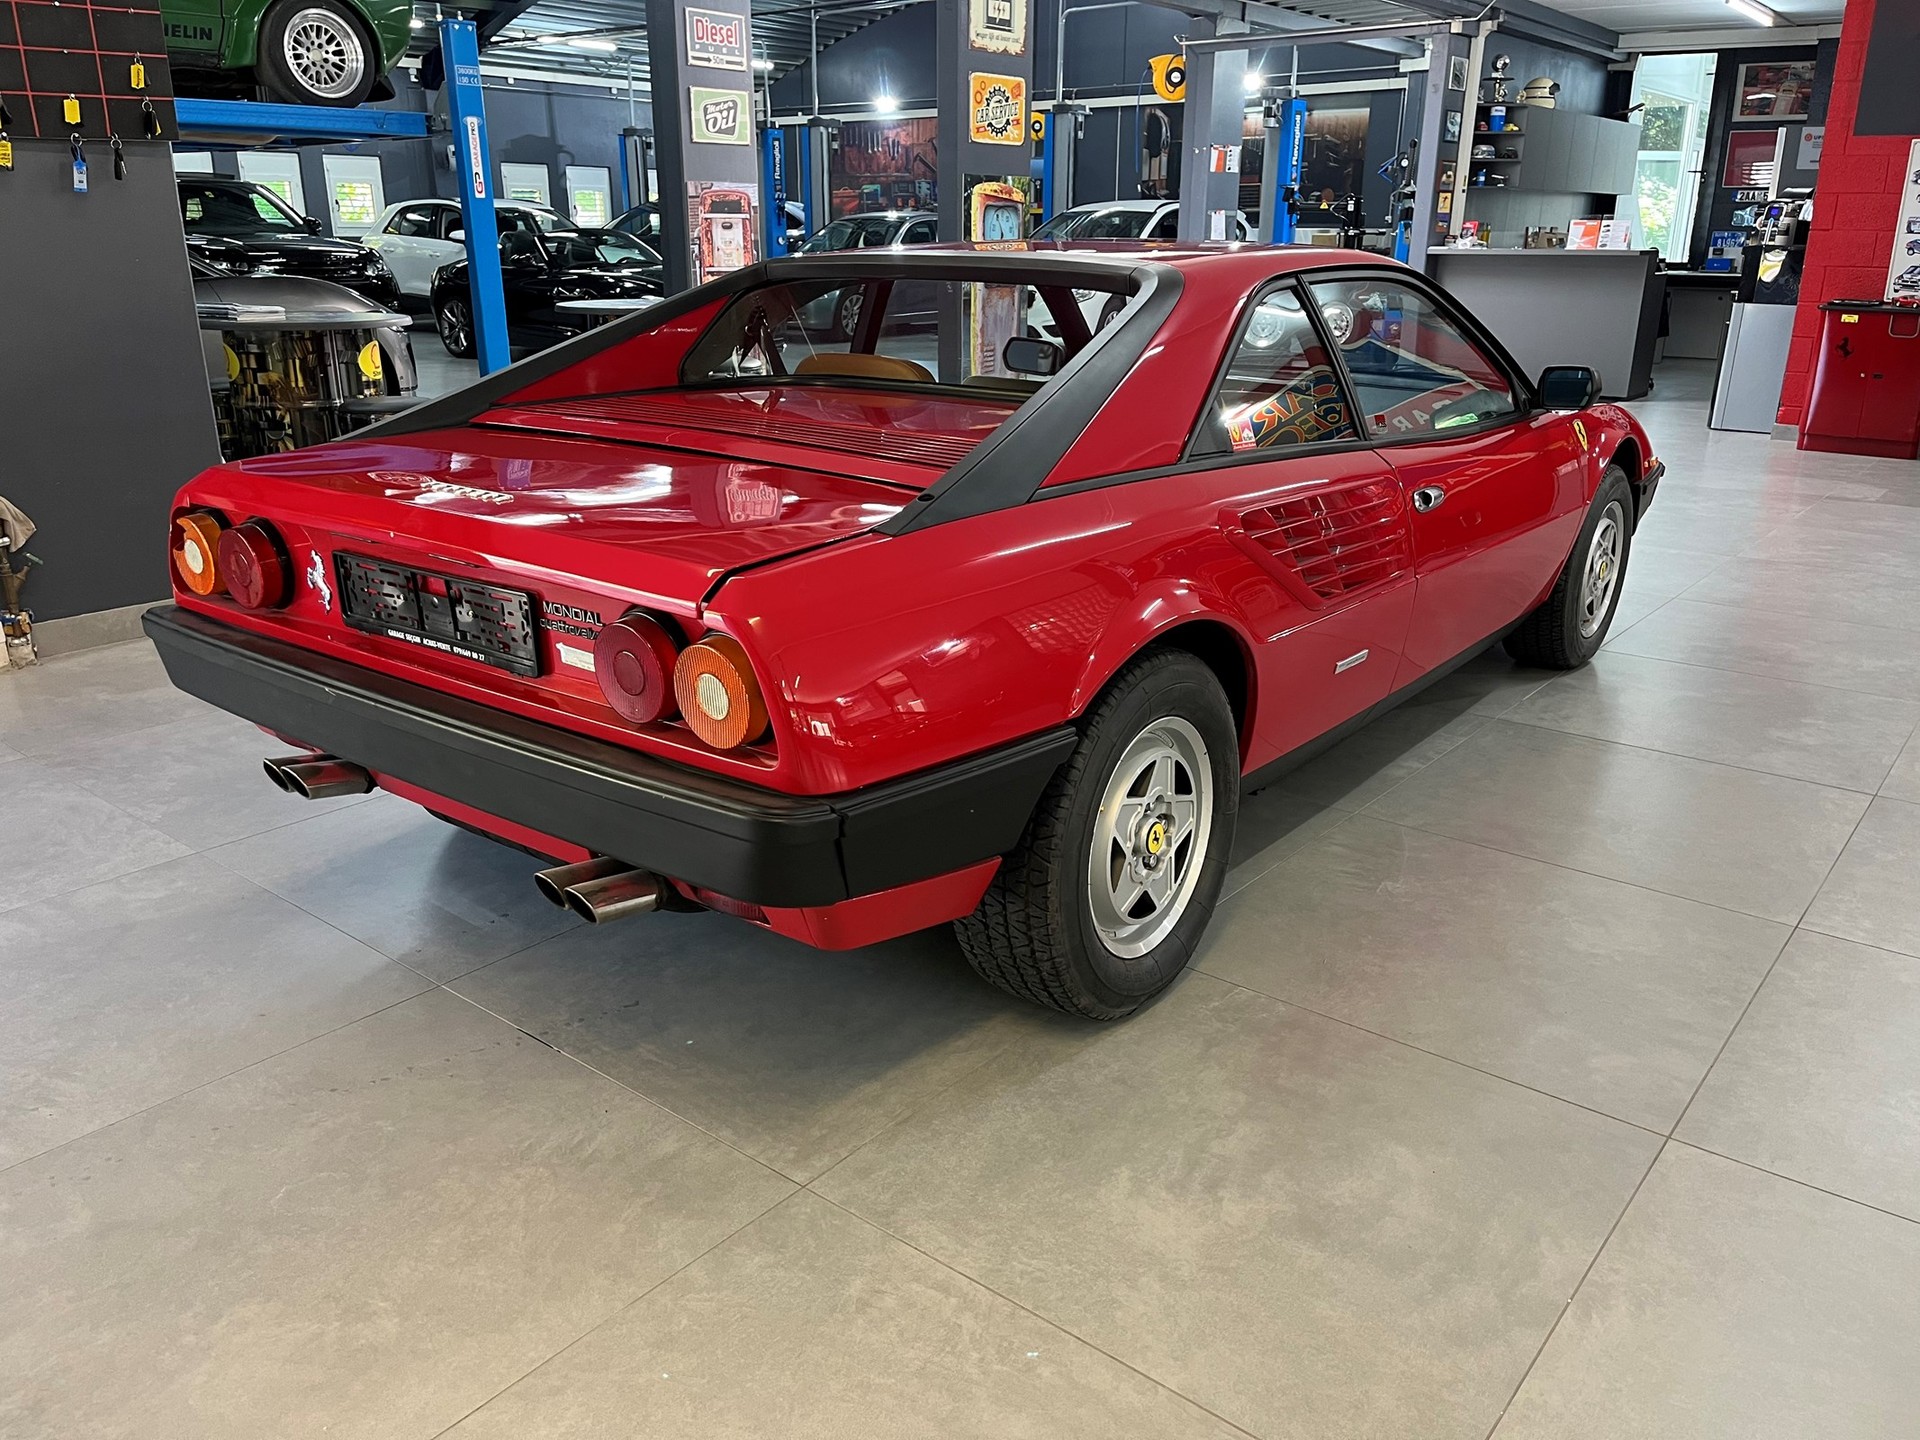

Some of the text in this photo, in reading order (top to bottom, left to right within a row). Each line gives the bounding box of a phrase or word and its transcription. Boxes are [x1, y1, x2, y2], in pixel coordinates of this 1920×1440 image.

[694, 16, 740, 48] Diesel
[695, 44, 740, 55] FUEL
[706, 101, 734, 114] Motor
[976, 101, 1019, 124] CAR SERVICE
[706, 109, 736, 133] Oil
[1292, 114, 1301, 166] Ravaglioli
[773, 140, 781, 179] Ravaglioli
[542, 601, 604, 627] MONDIAL
[387, 628, 405, 640] GARAGE
